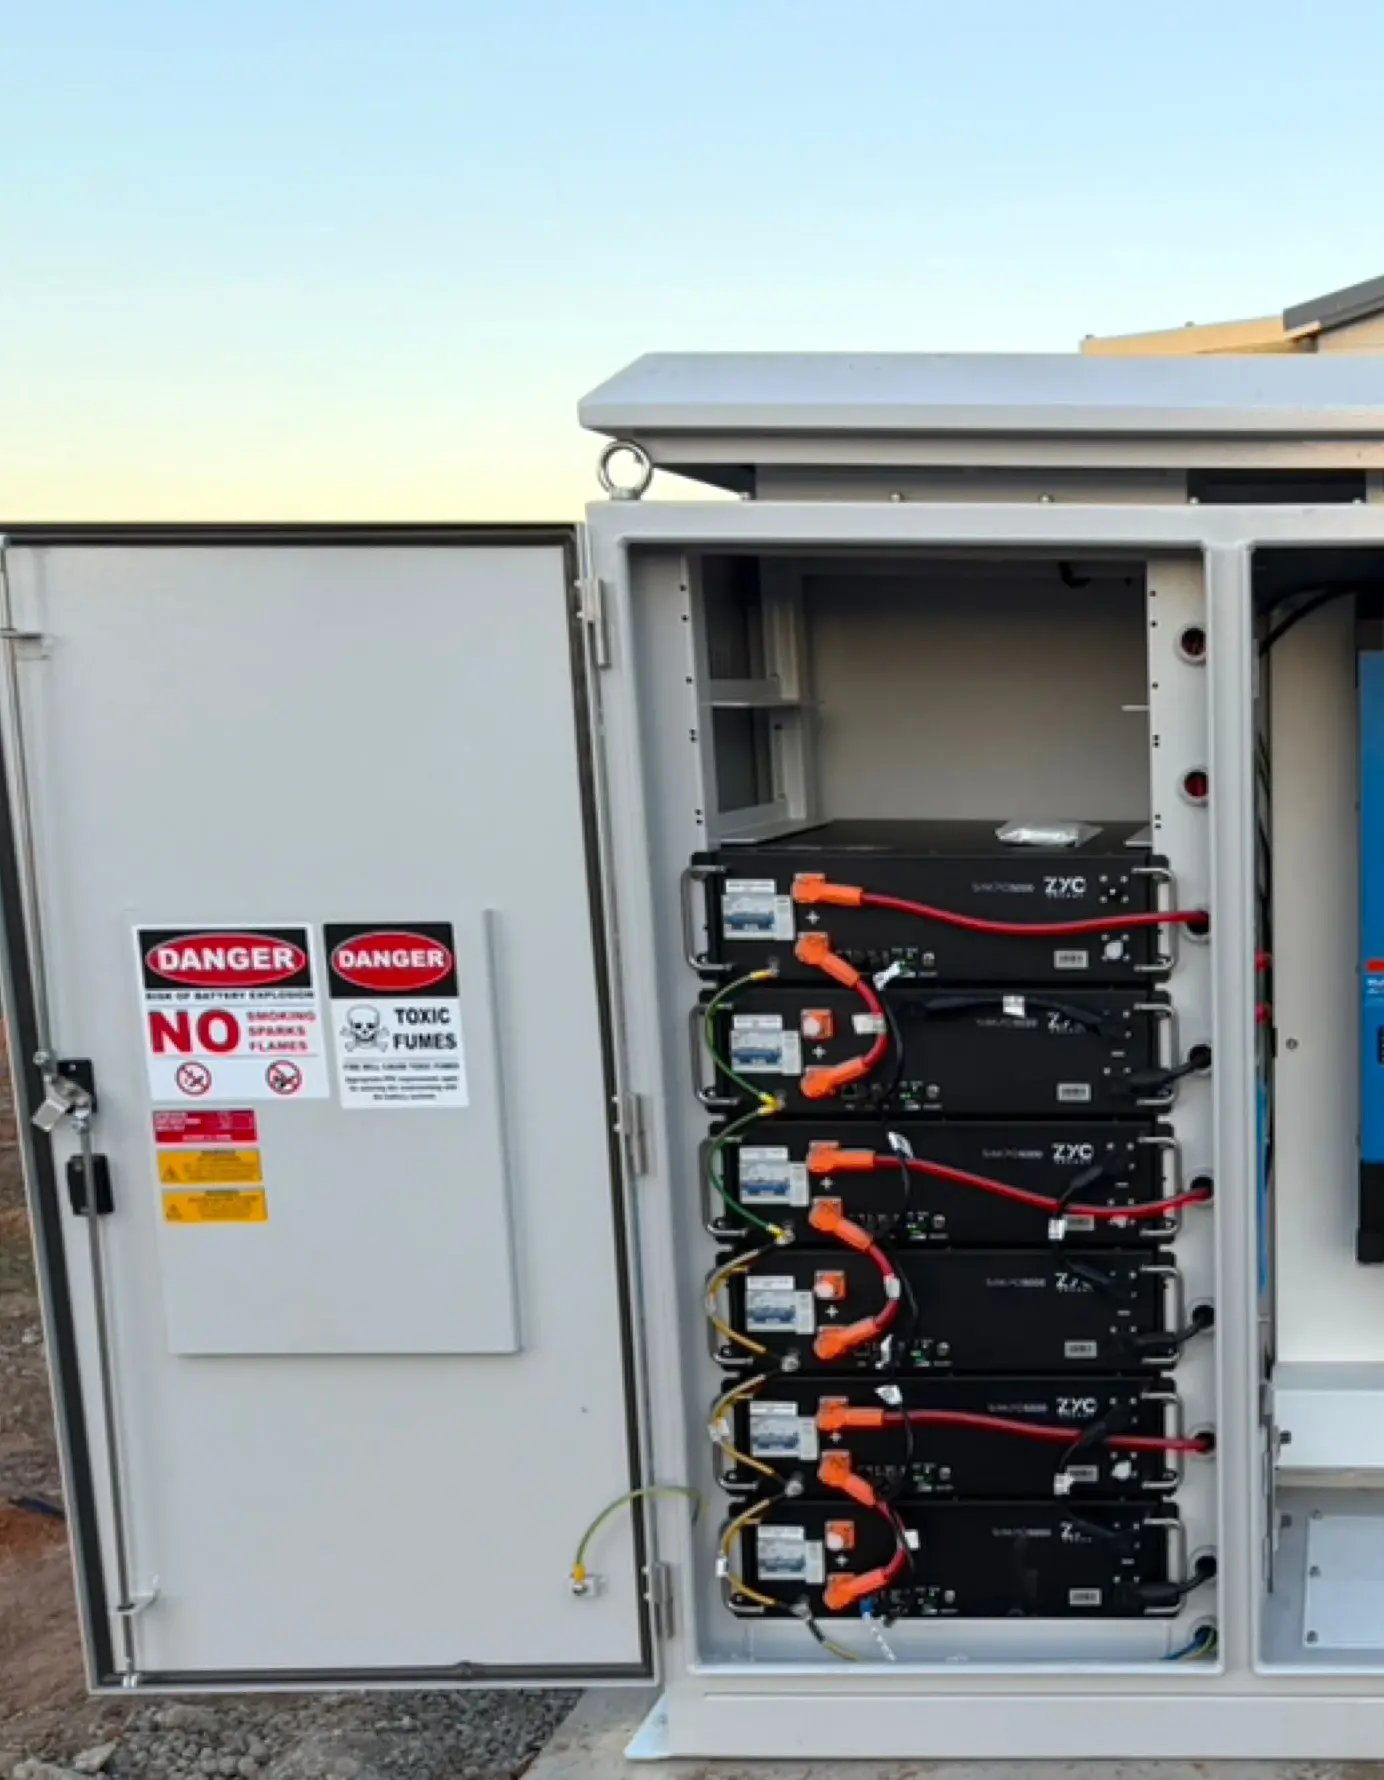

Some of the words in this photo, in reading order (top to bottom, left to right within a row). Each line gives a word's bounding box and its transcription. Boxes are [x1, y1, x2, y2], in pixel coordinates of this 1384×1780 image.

[1043, 876, 1086, 893] ZYC
[157, 947, 296, 971] DANGER
[338, 948, 445, 969] DANGER
[195, 992, 245, 1000] BATTERY
[249, 991, 314, 999] EXPLOSION
[247, 1011, 316, 1021] SMOKING
[394, 1007, 451, 1024] TOXIC
[149, 1009, 240, 1053] NO
[249, 1026, 306, 1036] SPARKS
[250, 1041, 307, 1051] FLAMES
[393, 1033, 458, 1050] FUMES
[1052, 1143, 1094, 1160] ZYC
[1056, 1397, 1097, 1413] ZYC
